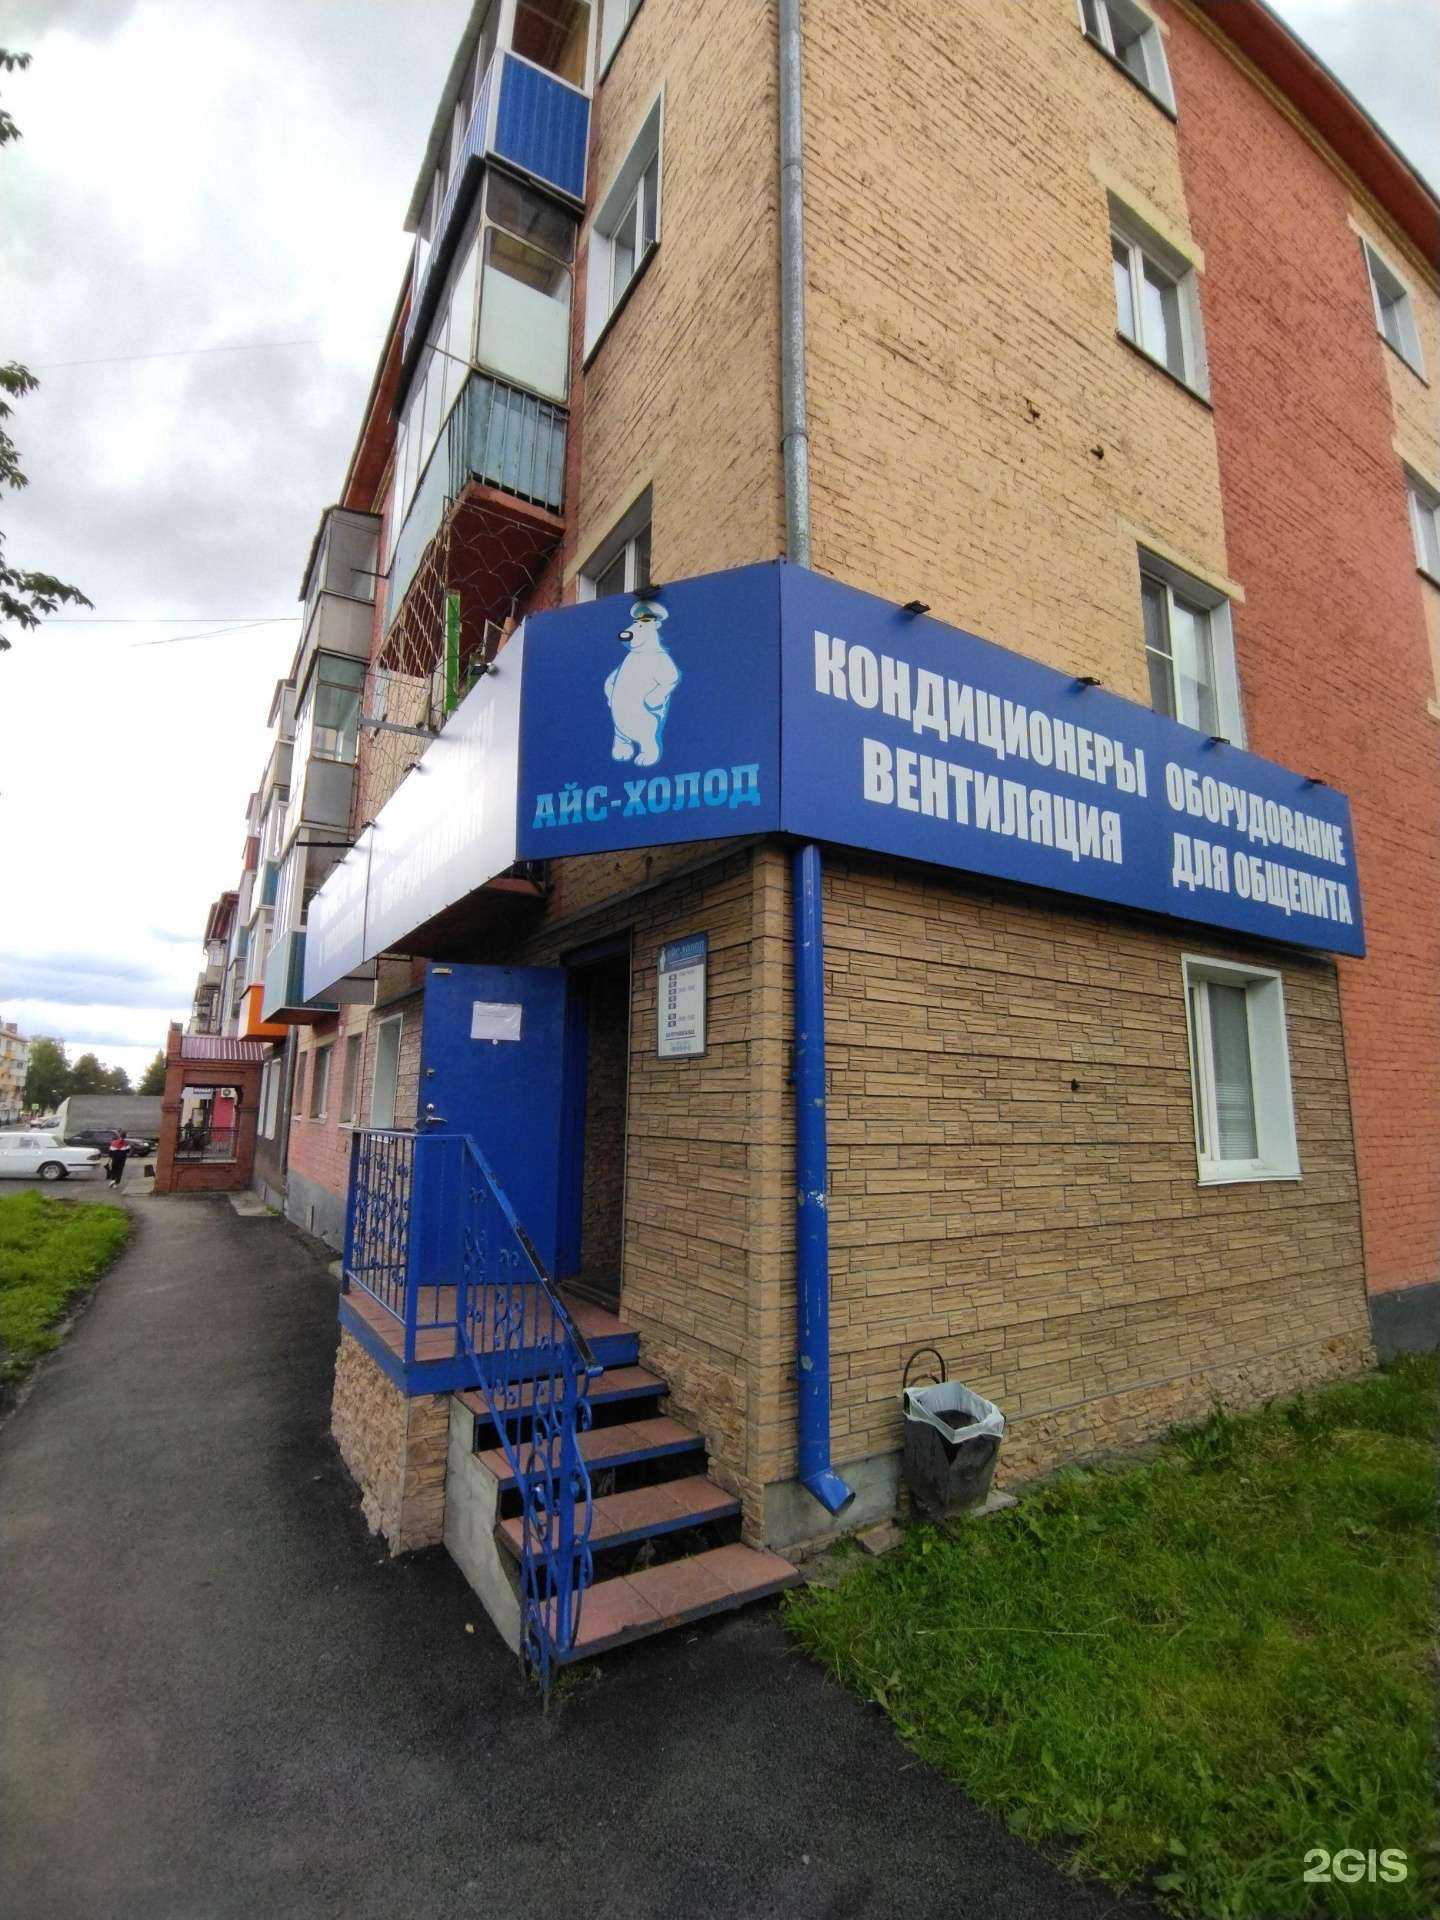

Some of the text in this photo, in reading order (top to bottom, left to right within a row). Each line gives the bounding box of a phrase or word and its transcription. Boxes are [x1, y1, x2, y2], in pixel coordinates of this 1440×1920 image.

[814, 630, 1147, 797] КОНДИЦИОНЕРЫ
[532, 763, 761, 828] АЙС-ХОЛОД
[863, 737, 1122, 864] ВЕНТИЛЯЦИЯ
[1165, 762, 1346, 865] ОБОРУДОВАНИЕ
[1172, 832, 1353, 925] ДЛЯ ОБЩЕПИТА
